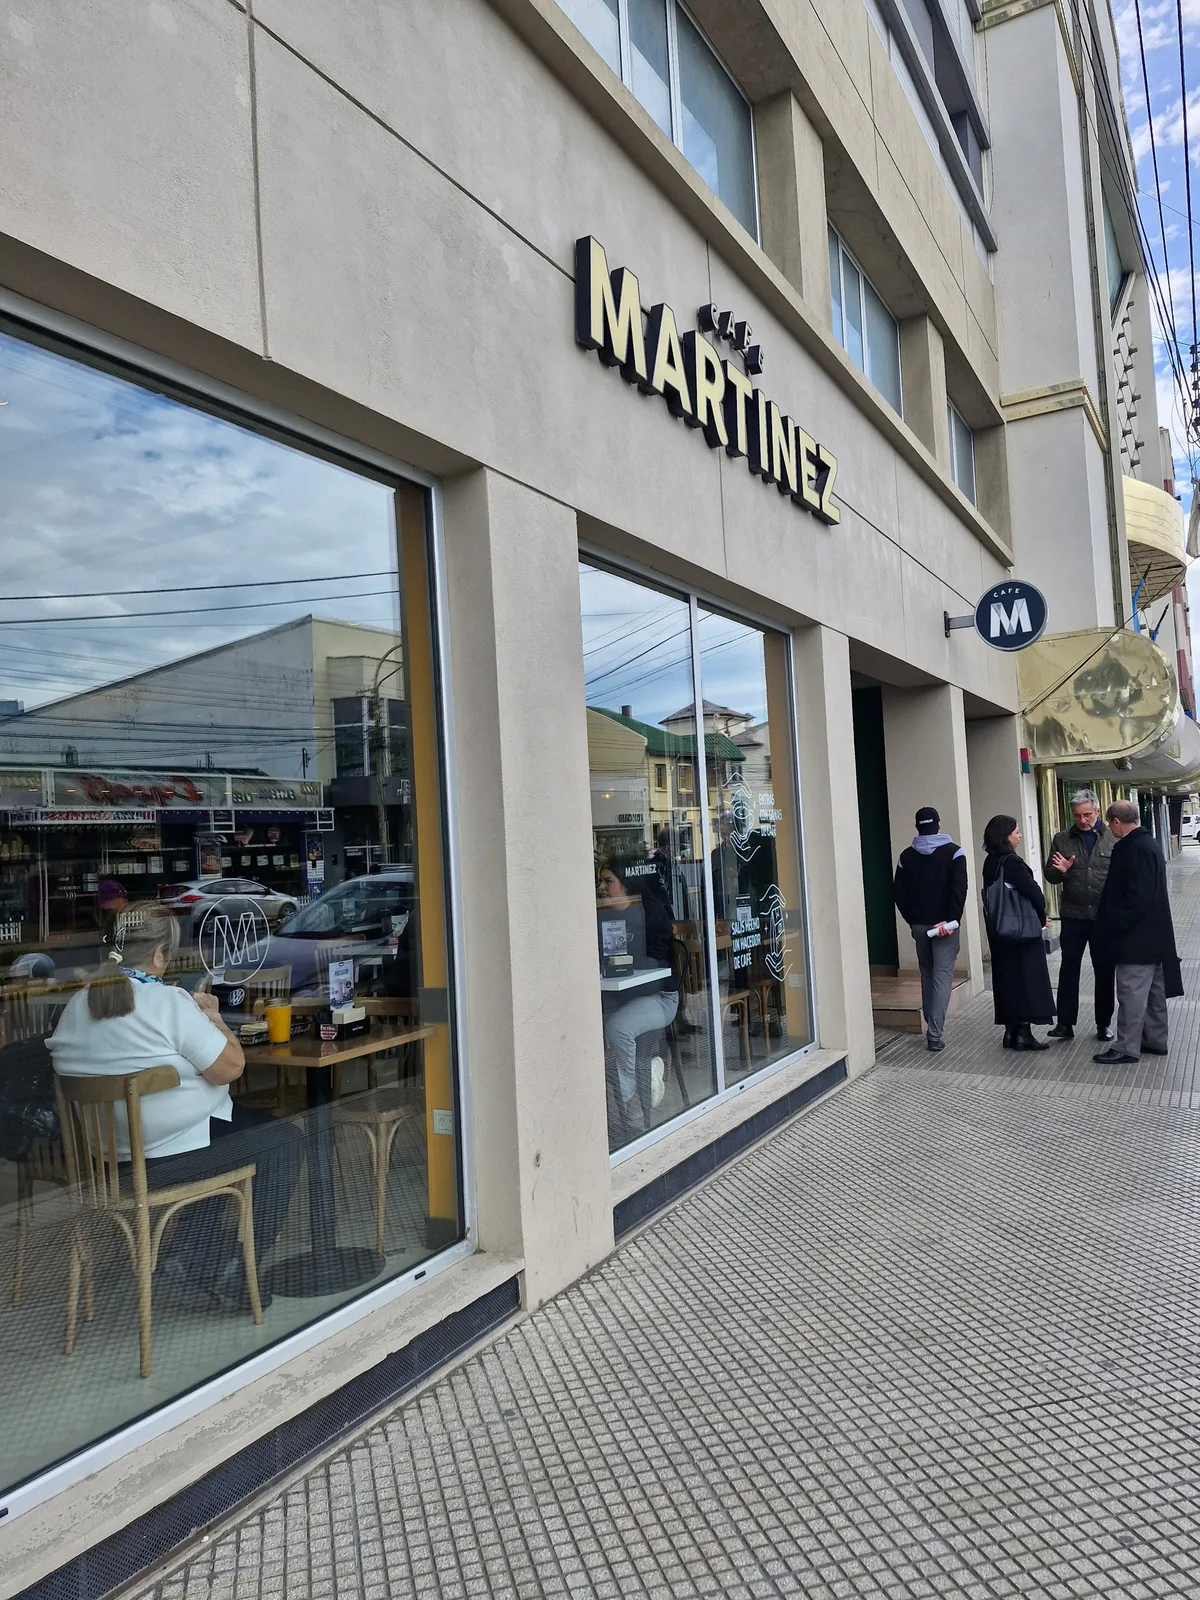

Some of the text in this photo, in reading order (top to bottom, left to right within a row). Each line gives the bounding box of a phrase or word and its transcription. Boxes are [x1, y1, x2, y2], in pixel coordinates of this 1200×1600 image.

[699, 303, 764, 375] CAFE
[576, 235, 841, 526] MARTINEZ
[993, 588, 1020, 598] CAFE
[990, 597, 1033, 638] M
[625, 864, 657, 877] MARTINEZ
[745, 917, 760, 932] HECHO
[732, 933, 761, 952] UN HACEDOR
[733, 955, 741, 970] DE
